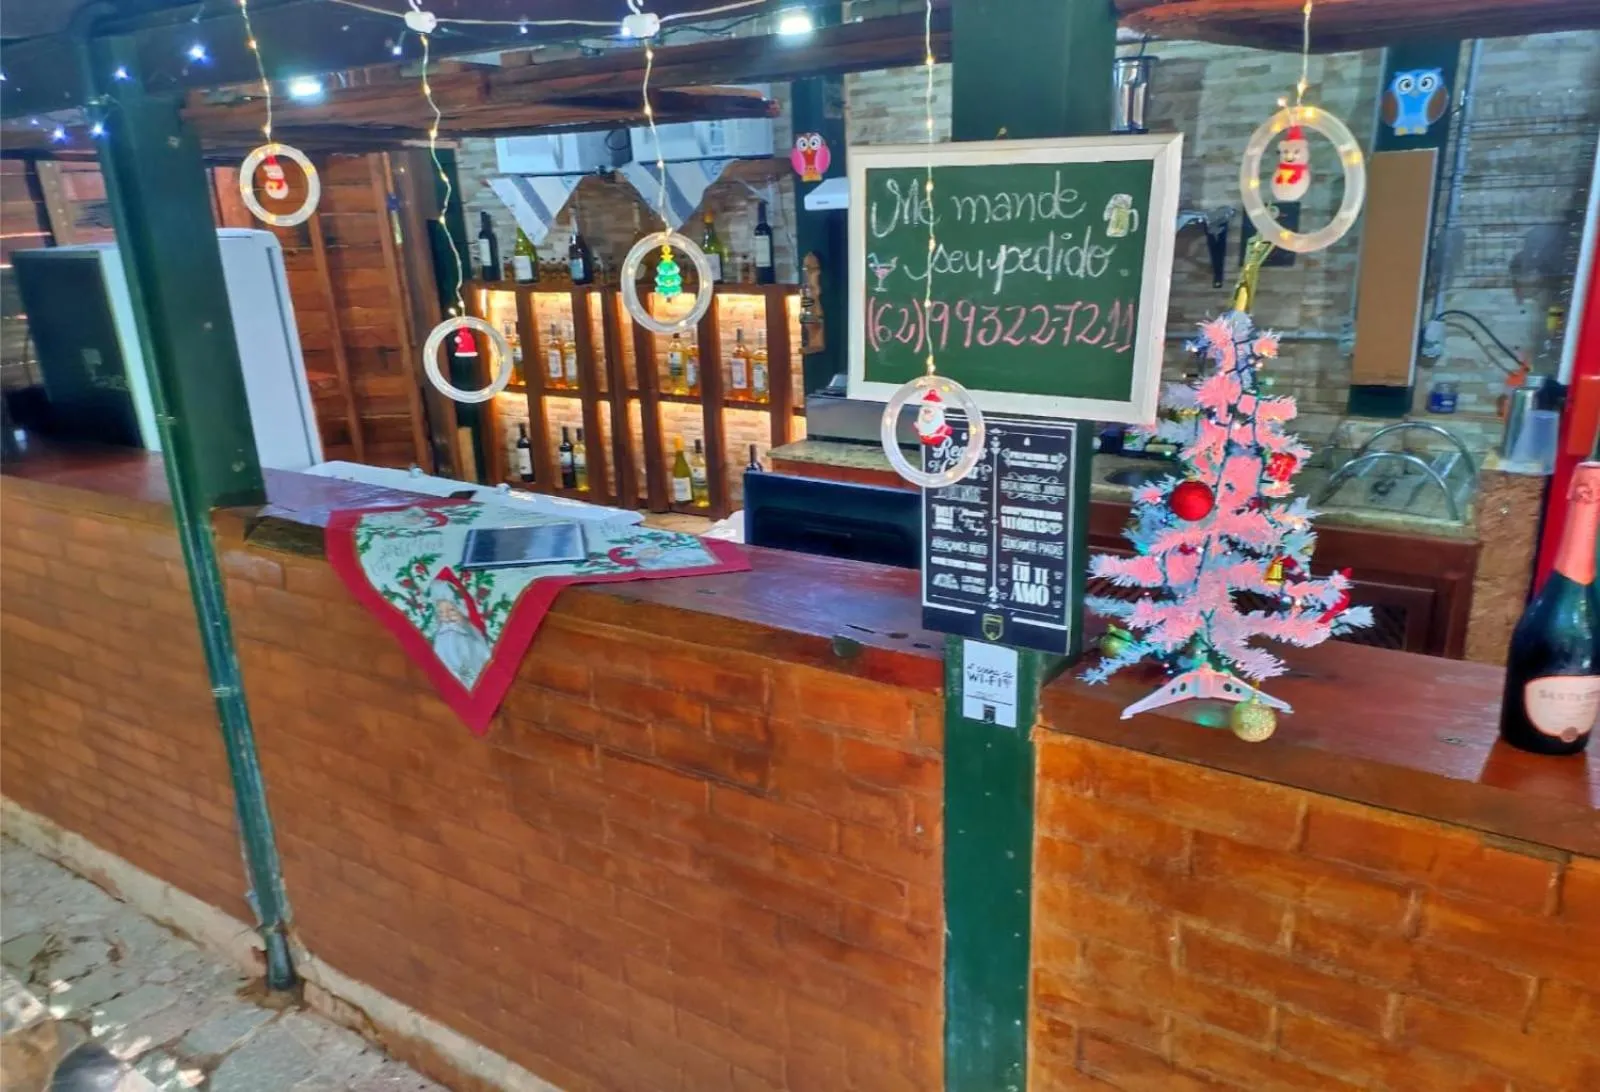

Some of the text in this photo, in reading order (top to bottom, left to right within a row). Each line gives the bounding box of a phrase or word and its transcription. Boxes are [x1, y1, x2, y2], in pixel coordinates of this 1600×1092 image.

[871, 171, 1087, 237] Me mande
[1009, 581, 1050, 607] AMO
